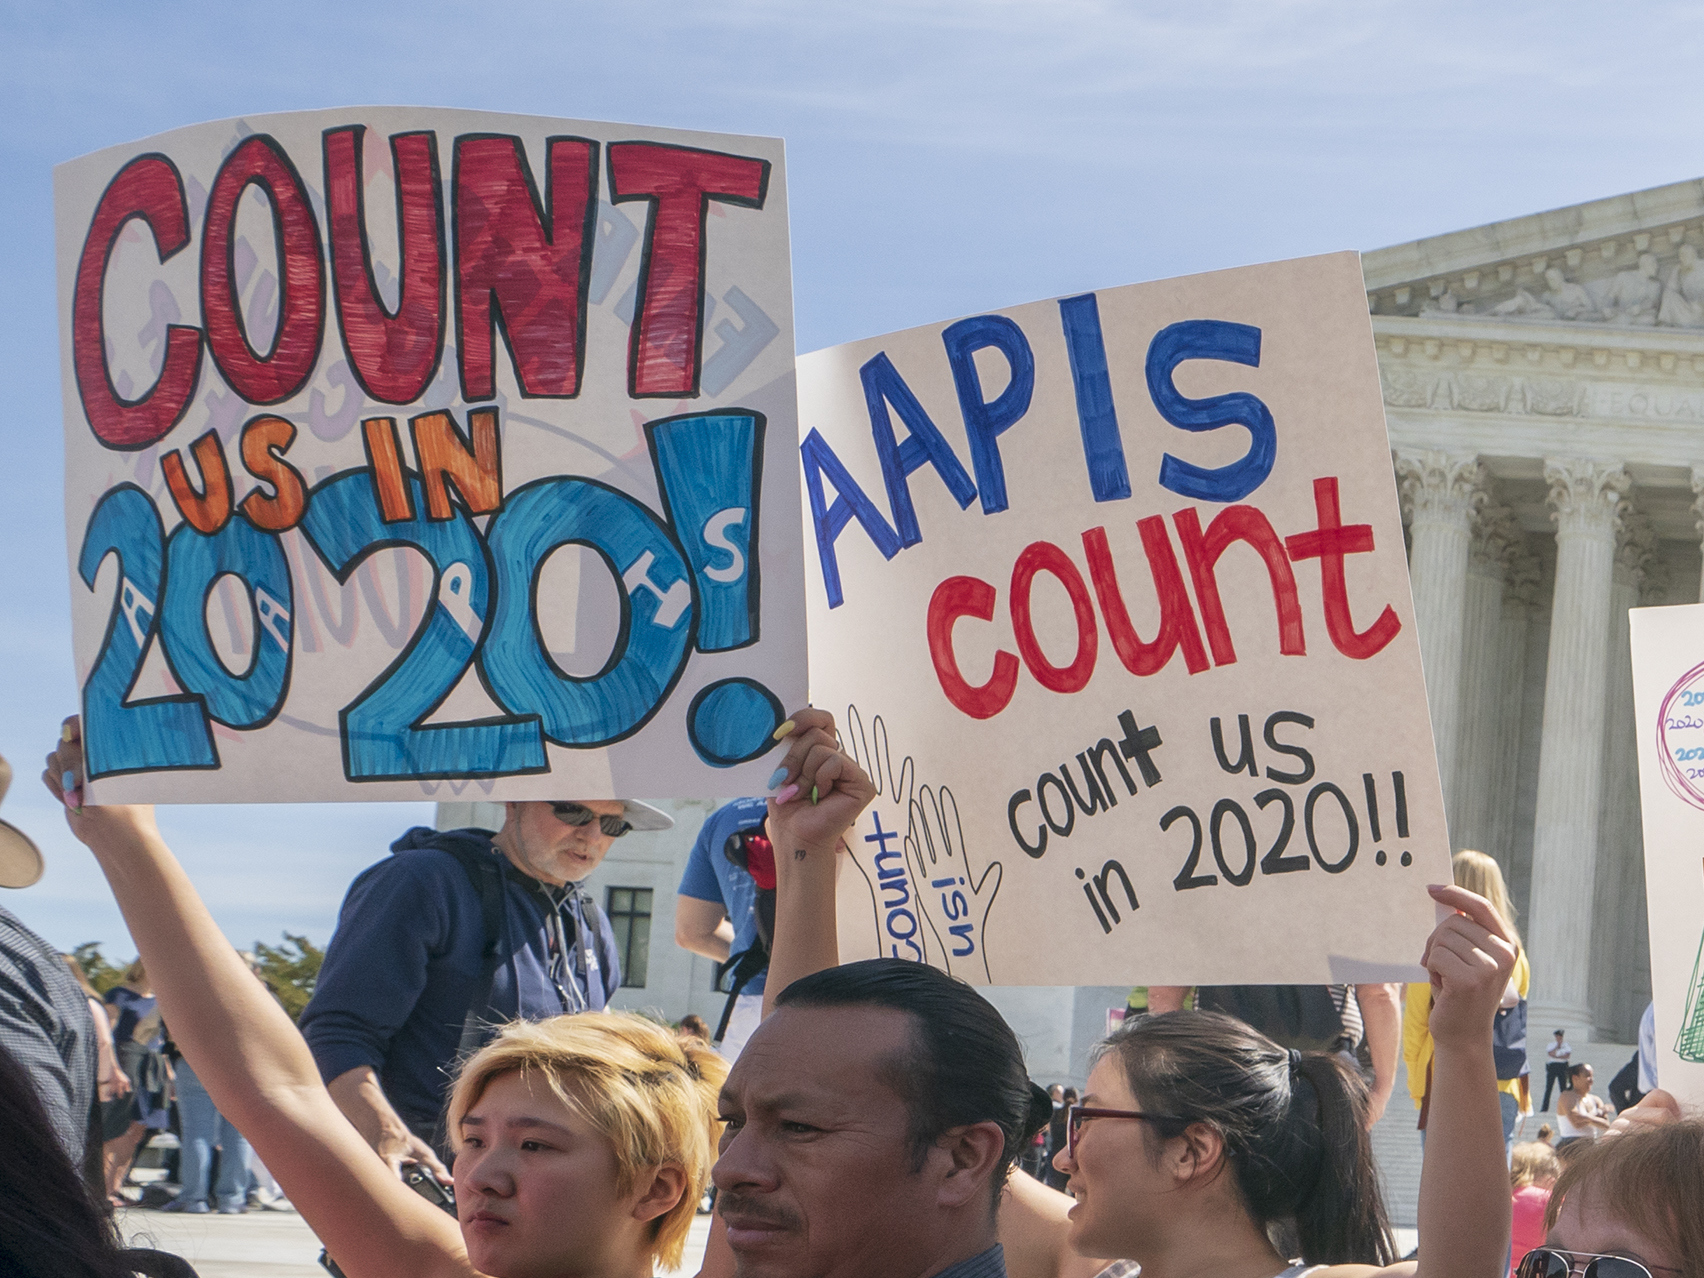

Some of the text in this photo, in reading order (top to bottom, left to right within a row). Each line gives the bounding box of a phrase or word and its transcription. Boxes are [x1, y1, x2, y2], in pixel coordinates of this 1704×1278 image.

[73, 124, 771, 452] COUNT
[160, 406, 506, 536] US IN
[799, 292, 1277, 610] AAPIS
[78, 407, 787, 783] 2020!
[926, 476, 1402, 720] count
[1008, 710, 1316, 859] count us
[1075, 770, 1413, 934] in 2020!!
[864, 811, 923, 963] count
[930, 876, 975, 958] us!
